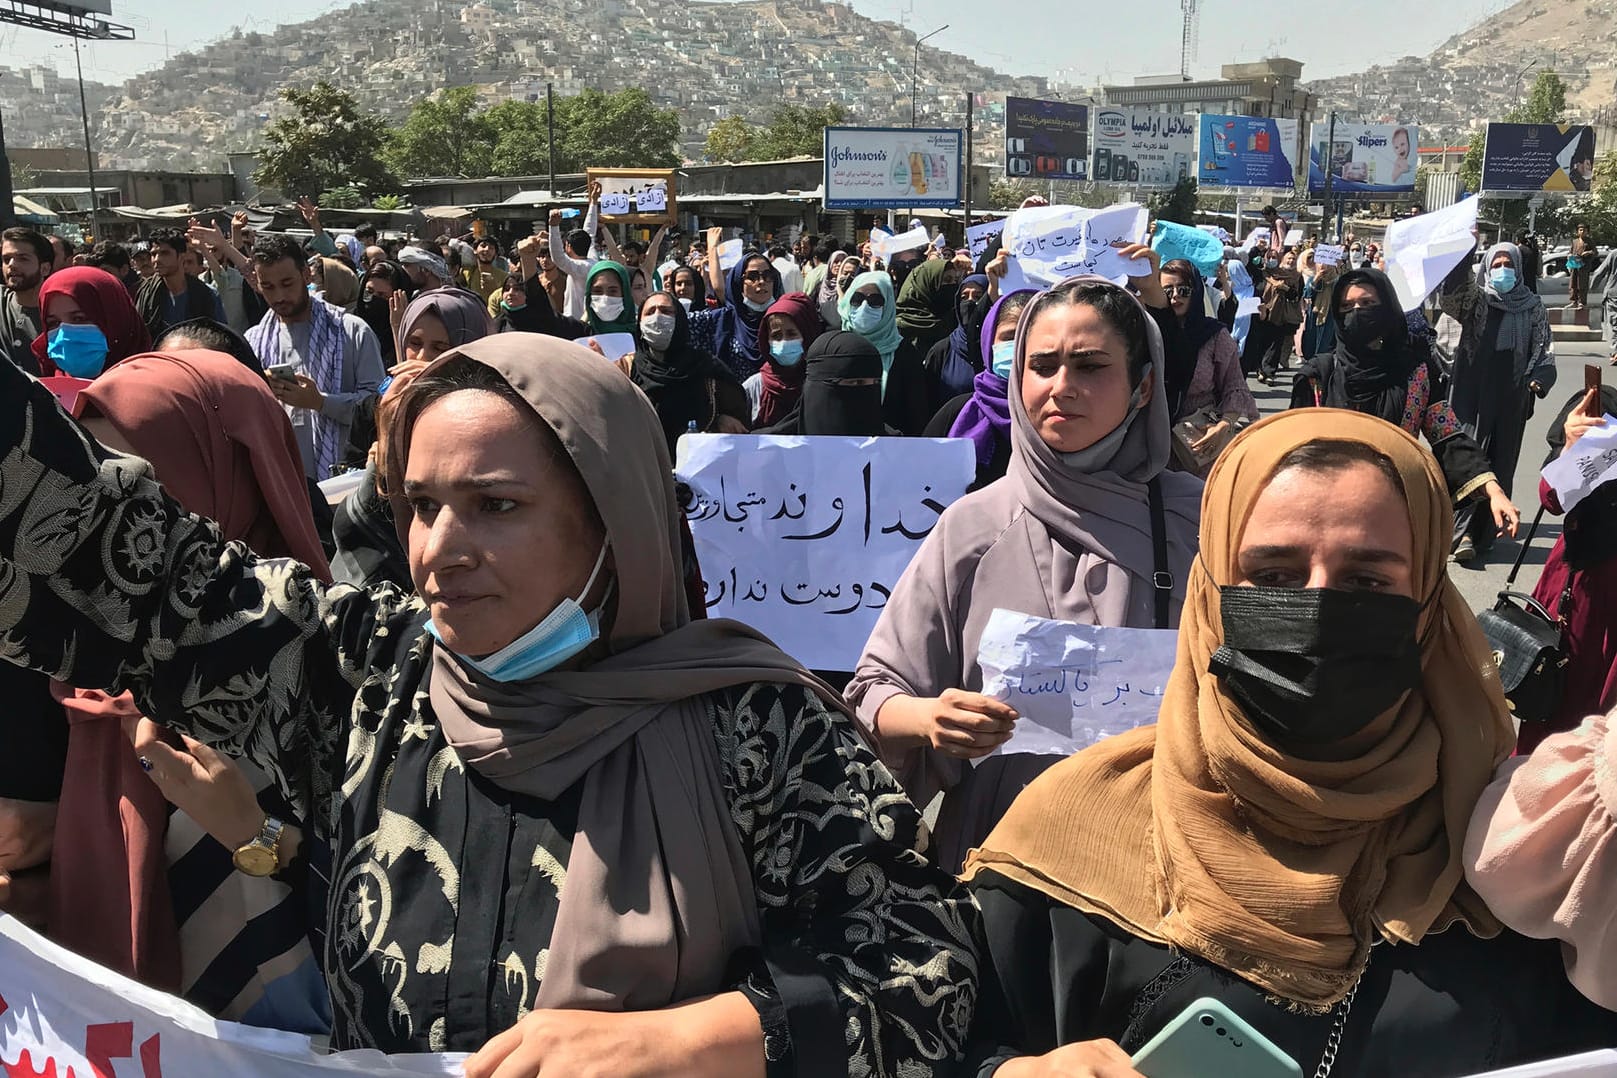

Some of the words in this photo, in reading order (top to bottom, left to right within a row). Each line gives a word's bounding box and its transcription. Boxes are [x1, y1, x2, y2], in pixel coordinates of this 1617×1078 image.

[1099, 118, 1126, 127] OLYMPIA
[831, 146, 888, 168] Johnson's
[780, 579, 891, 615] دوست
